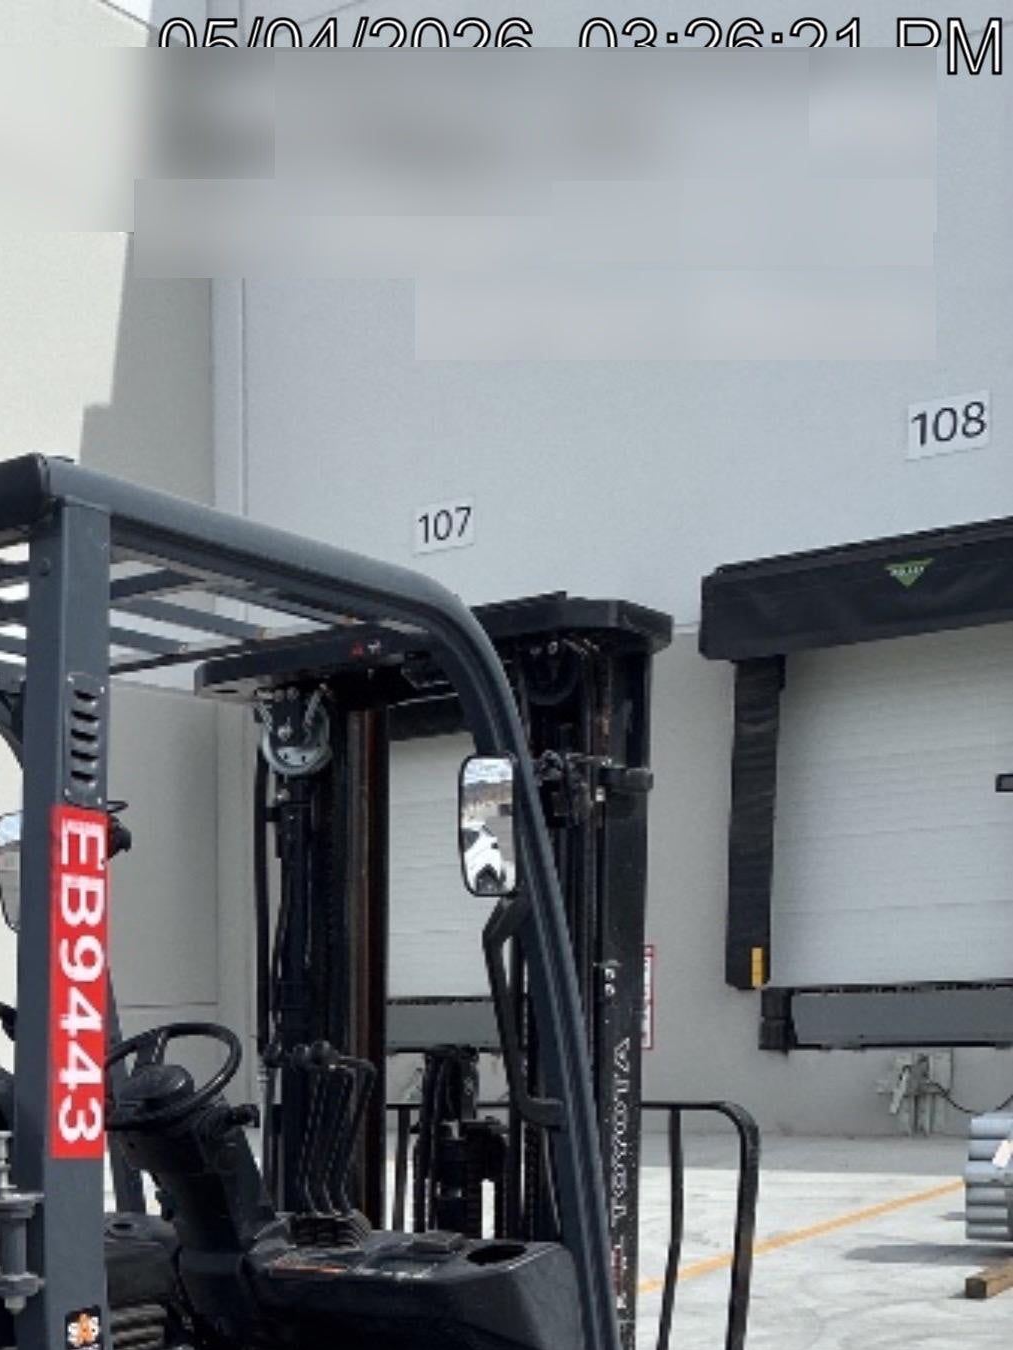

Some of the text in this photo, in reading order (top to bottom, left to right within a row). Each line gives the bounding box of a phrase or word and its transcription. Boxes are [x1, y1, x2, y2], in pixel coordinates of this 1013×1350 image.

[911, 401, 986, 446] 108
[417, 506, 472, 543] 107
[59, 818, 105, 1143] EB9443
